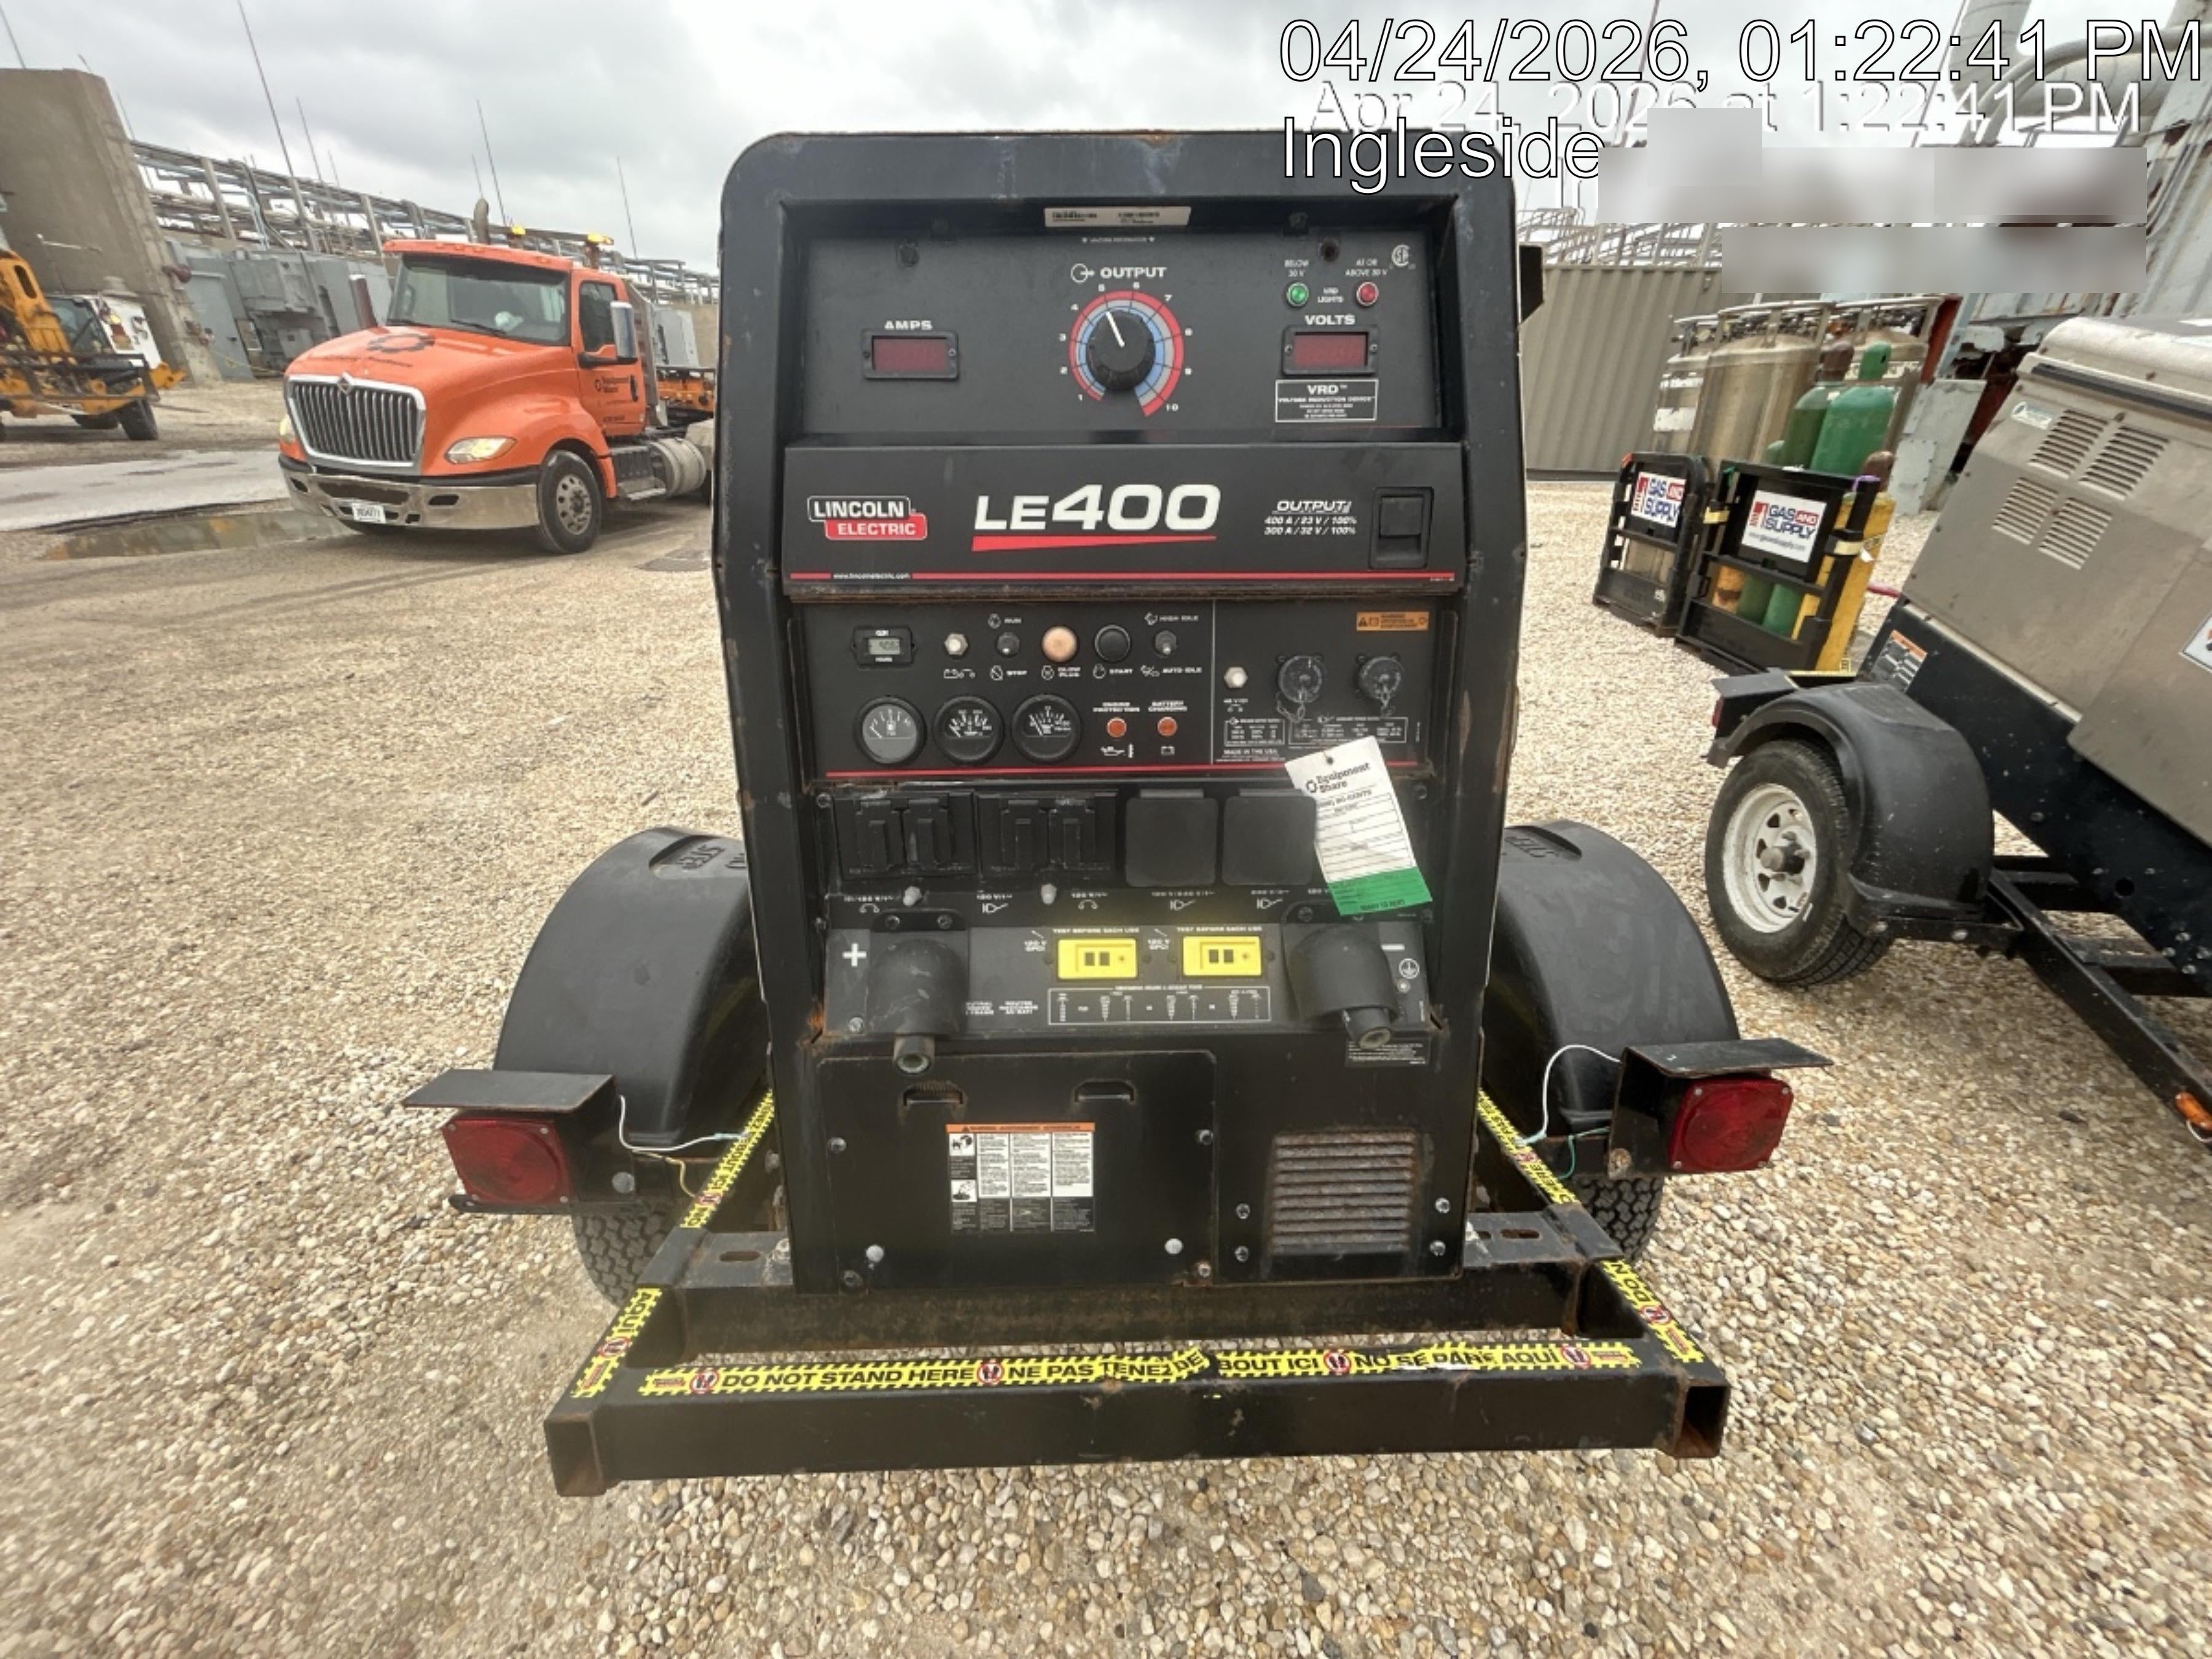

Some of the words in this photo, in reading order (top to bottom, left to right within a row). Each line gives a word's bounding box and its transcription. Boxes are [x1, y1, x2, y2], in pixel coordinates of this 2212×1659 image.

[1100, 267, 1167, 278] OUTPUT
[884, 320, 933, 331] AMPS
[1304, 315, 1355, 325] VOLTS
[1166, 403, 1179, 412] 10
[814, 500, 905, 518] LINCOLN
[974, 484, 1221, 530] LE400
[1277, 500, 1348, 512] OUTPUT
[1769, 504, 1795, 520] GAS
[1797, 512, 1818, 525] AND
[837, 522, 916, 536] ELECTRIC
[1765, 517, 1816, 539] SUPPLY
[1319, 781, 1347, 793] Share
[721, 1375, 752, 1387] DO
[765, 1373, 814, 1385] NOT
[820, 1371, 902, 1384] STAND
[909, 1370, 974, 1382] HERE
[1008, 1368, 1033, 1378] NE
[1046, 1365, 1094, 1377] PAS
[1101, 1362, 1172, 1376] TENEZ
[1292, 1359, 1320, 1370] ICI
[1355, 1354, 1390, 1367] NO
[1397, 1354, 1428, 1367] SE
